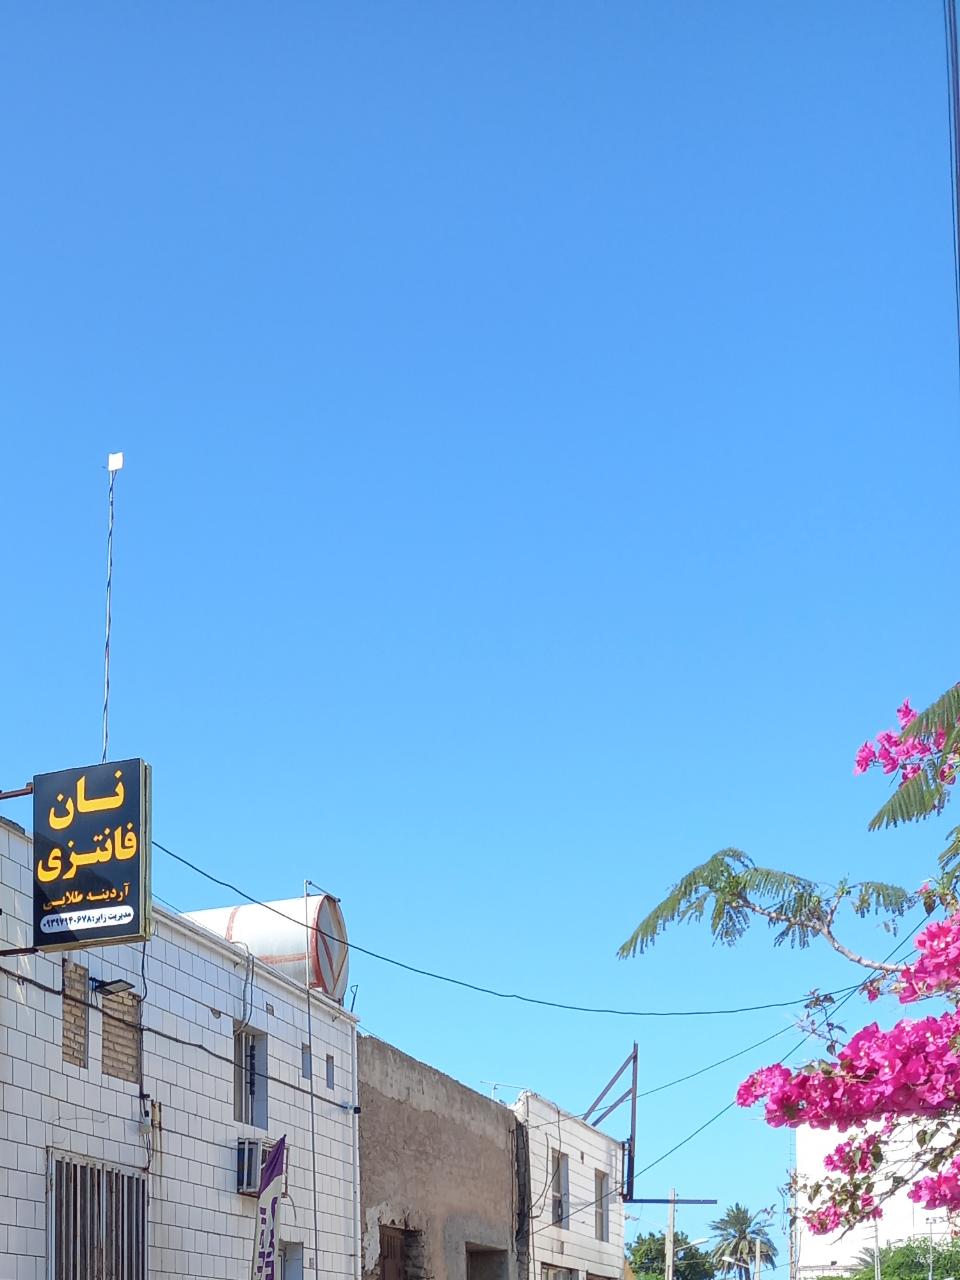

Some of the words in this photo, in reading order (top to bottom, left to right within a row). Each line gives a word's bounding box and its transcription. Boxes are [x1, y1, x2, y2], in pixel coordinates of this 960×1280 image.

[48, 769, 126, 830] نان
[36, 822, 138, 882] فانتزی
[42, 890, 84, 910] طلایی
